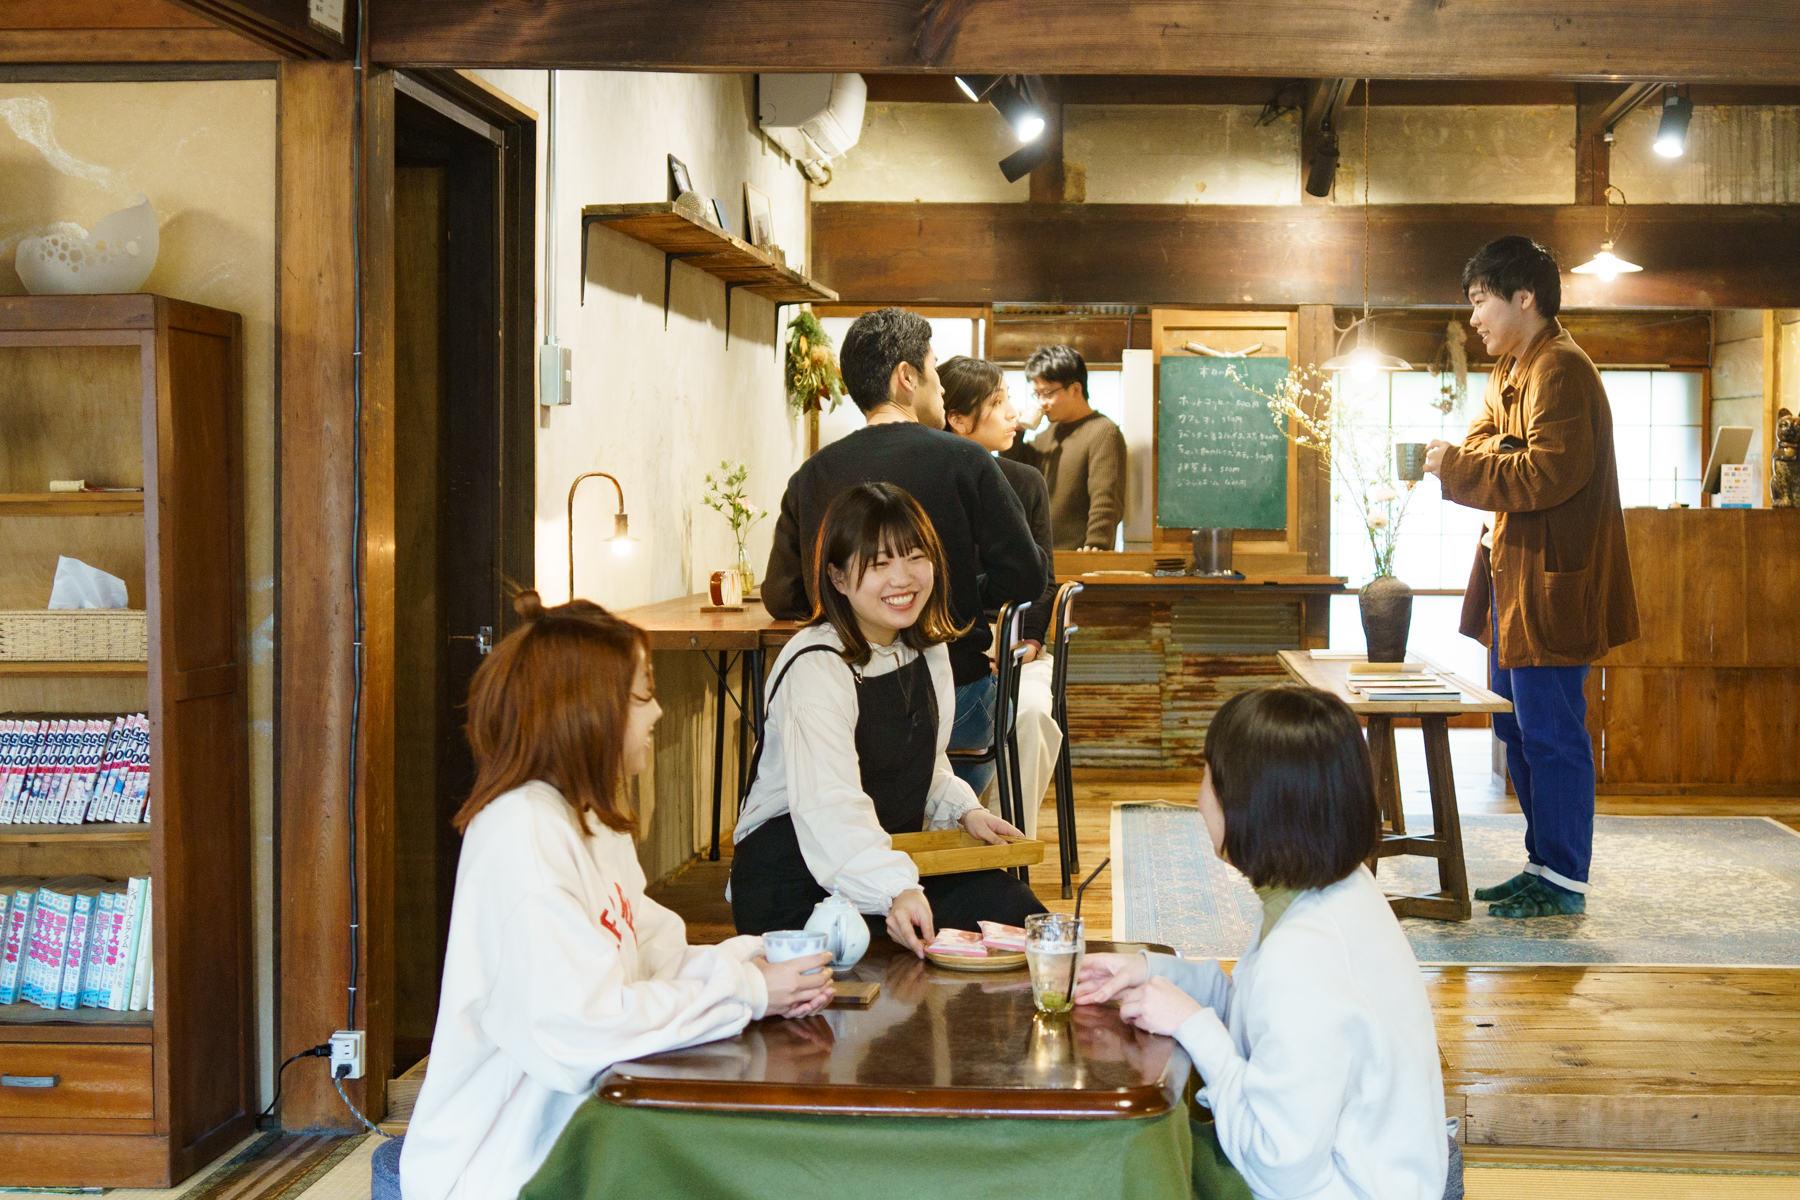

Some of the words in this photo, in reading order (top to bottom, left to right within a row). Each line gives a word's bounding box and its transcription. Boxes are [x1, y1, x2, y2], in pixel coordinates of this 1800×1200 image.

[4, 733, 19, 765] GTO
[14, 733, 28, 765] GTO
[20, 733, 35, 766] GTO
[30, 733, 45, 765] GTO
[40, 733, 55, 765] GTO
[49, 733, 64, 765] GTO
[58, 733, 73, 765] GTO
[67, 733, 82, 765] GTO
[77, 733, 91, 764] GTO
[84, 734, 99, 765] GTO
[92, 733, 107, 764] GTO
[105, 730, 120, 762] GTO
[114, 728, 131, 760] GTO
[125, 727, 140, 758] GTO
[131, 732, 145, 764] GTO
